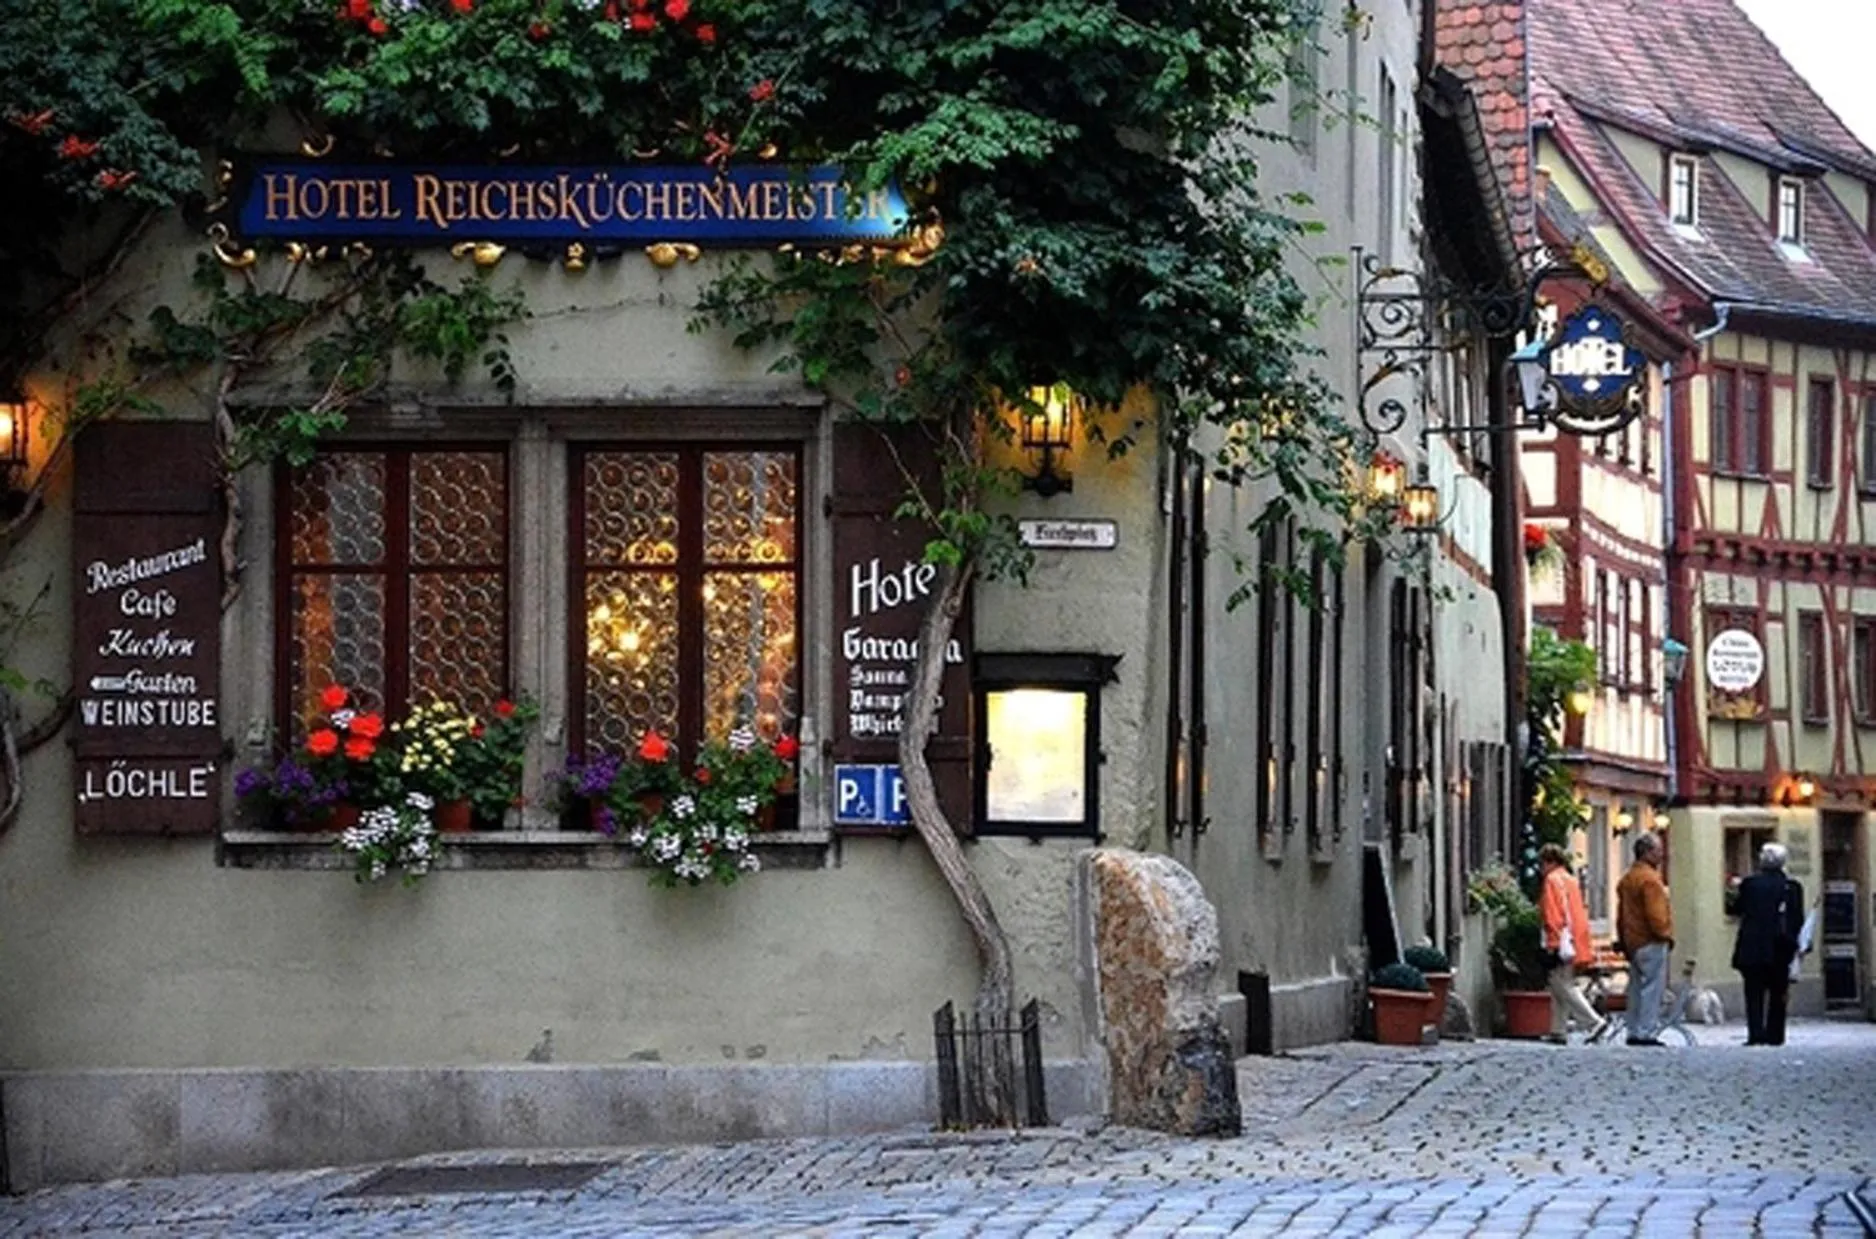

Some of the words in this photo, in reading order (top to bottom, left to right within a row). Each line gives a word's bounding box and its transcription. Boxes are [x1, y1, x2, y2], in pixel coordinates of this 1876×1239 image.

[264, 173, 402, 220] HOTEL
[1551, 338, 1633, 376] HOTEL
[86, 537, 206, 594] Restaurant
[121, 588, 177, 619] Cafe
[852, 557, 936, 618] Hote
[98, 629, 196, 660] Kuchen
[81, 700, 216, 726] WEINSTUBE
[840, 778, 859, 813] P
